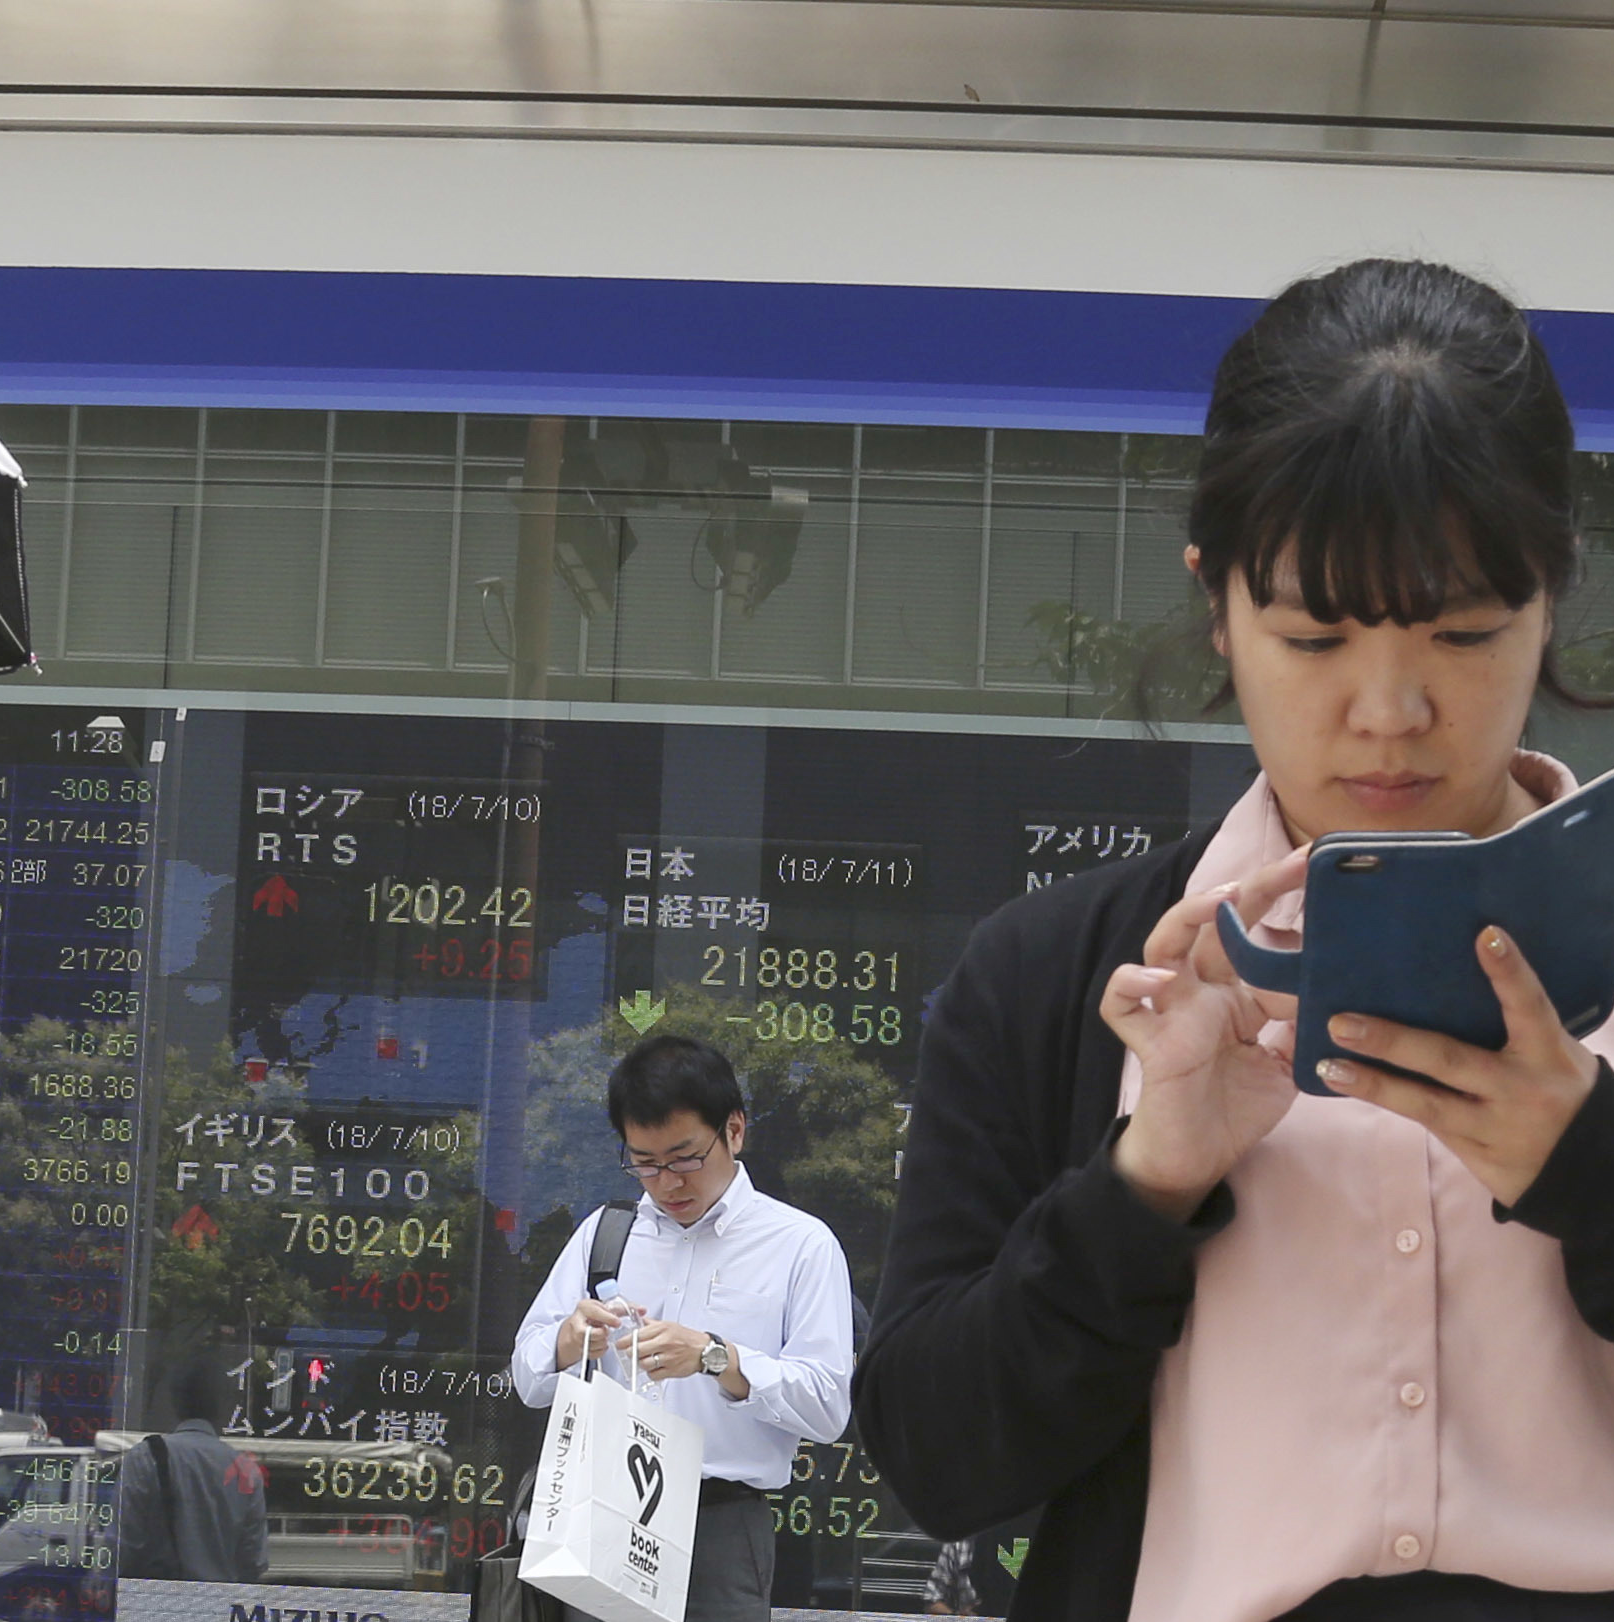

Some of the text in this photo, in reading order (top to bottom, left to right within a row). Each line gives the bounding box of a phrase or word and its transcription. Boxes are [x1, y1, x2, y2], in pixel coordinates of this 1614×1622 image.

[51, 729, 123, 753] 11:28
[51, 779, 152, 802] -308.58
[255, 785, 364, 818] ロシア
[25, 819, 150, 845] 21744.25
[1025, 824, 1152, 858] アメリカ
[73, 862, 147, 887] 37.07
[623, 847, 696, 881] 日本
[85, 905, 146, 930] -320
[364, 882, 533, 928] 1202.42
[622, 895, 771, 930] 日経平均
[59, 947, 143, 971] 21720
[413, 938, 533, 980] +9.25
[699, 945, 898, 992] 21888.31
[80, 990, 140, 1015] -325
[726, 1000, 902, 1046] -308.58
[53, 1032, 138, 1057] -18.55
[30, 1073, 135, 1099] 1688.36
[49, 1116, 132, 1142] -21.88
[175, 1114, 297, 1147] イギリス
[23, 1158, 130, 1184] 3766.19
[71, 1203, 128, 1228] 0.00
[281, 1212, 452, 1259] 7692.04
[330, 1271, 451, 1312] +4.05
[53, 1331, 122, 1356] -0.14
[226, 1357, 336, 1394] インド
[222, 1403, 450, 1447] ムンバイ指数
[632, 1420, 662, 1451] yaesu
[14, 1457, 116, 1485] -456.52
[547, 1401, 578, 1533] 八重洲ブックセンター
[791, 1441, 880, 1485] 5.73
[304, 1457, 505, 1506] 36239.62
[765, 1494, 880, 1539] 56.52
[27, 1544, 113, 1570] -13.50
[630, 1526, 661, 1562] book
[627, 1550, 660, 1577] center
